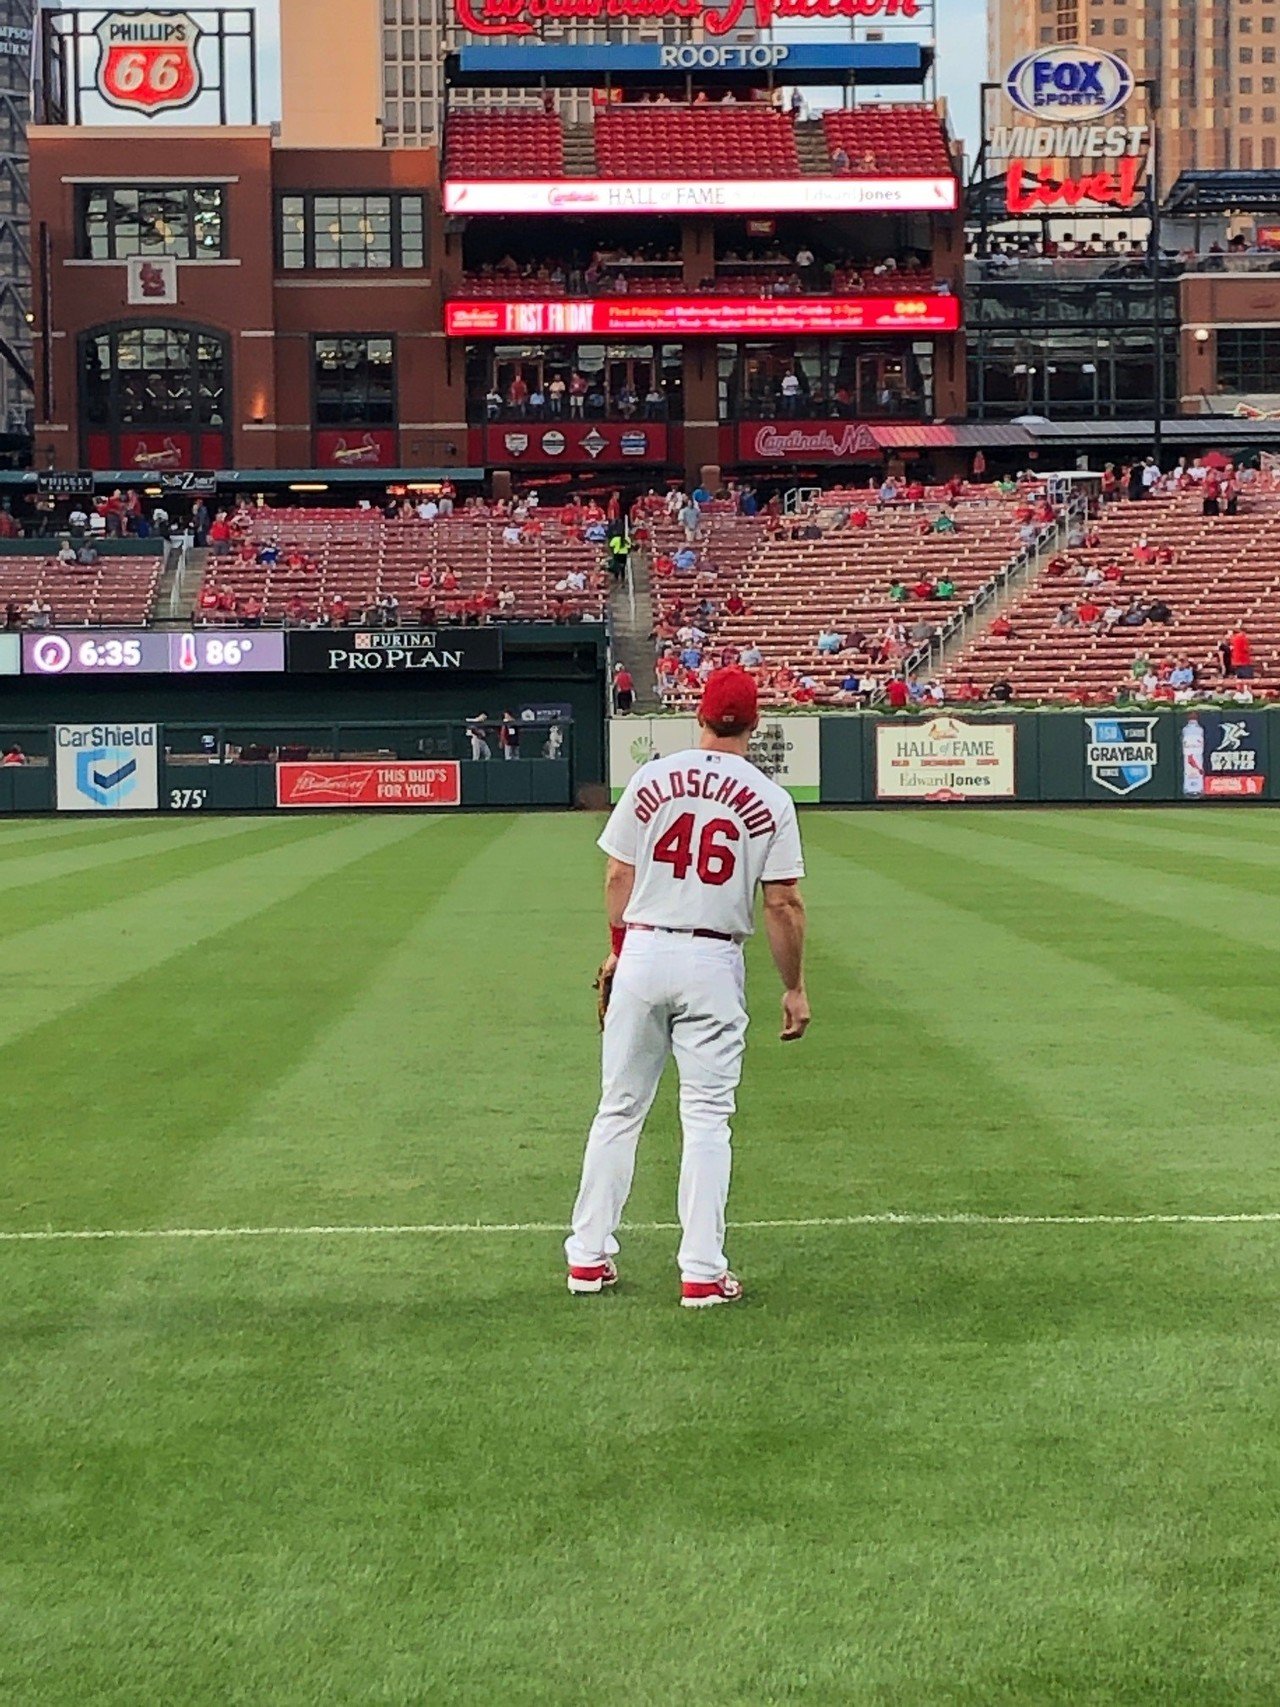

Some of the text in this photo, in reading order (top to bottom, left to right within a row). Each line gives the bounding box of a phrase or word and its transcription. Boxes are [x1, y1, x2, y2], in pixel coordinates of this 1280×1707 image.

[110, 23, 187, 41] PHILLIPS
[660, 45, 789, 67] ROOFTOP
[115, 53, 183, 92] 66
[1033, 61, 1104, 93] FOX
[1033, 92, 1106, 106] SPORTS
[989, 126, 1149, 158] MIDWEST
[608, 187, 657, 205] HALL
[676, 187, 726, 205] FAME
[505, 303, 544, 333] FIRST
[547, 303, 595, 333] FRIDAY
[372, 634, 433, 648] PURINA
[78, 640, 142, 667] 6:35
[206, 639, 253, 666] 86°
[57, 727, 154, 747] CarShield
[897, 741, 938, 757] HALL
[952, 740, 995, 757] FAME
[1090, 746, 1154, 762] GRAYBAR
[377, 769, 447, 784] THIS BUD'S
[170, 789, 207, 809] 375'
[377, 784, 434, 798] FOR YOU.
[634, 768, 777, 839] GOLDSCHMIDT
[652, 812, 740, 886] 46
